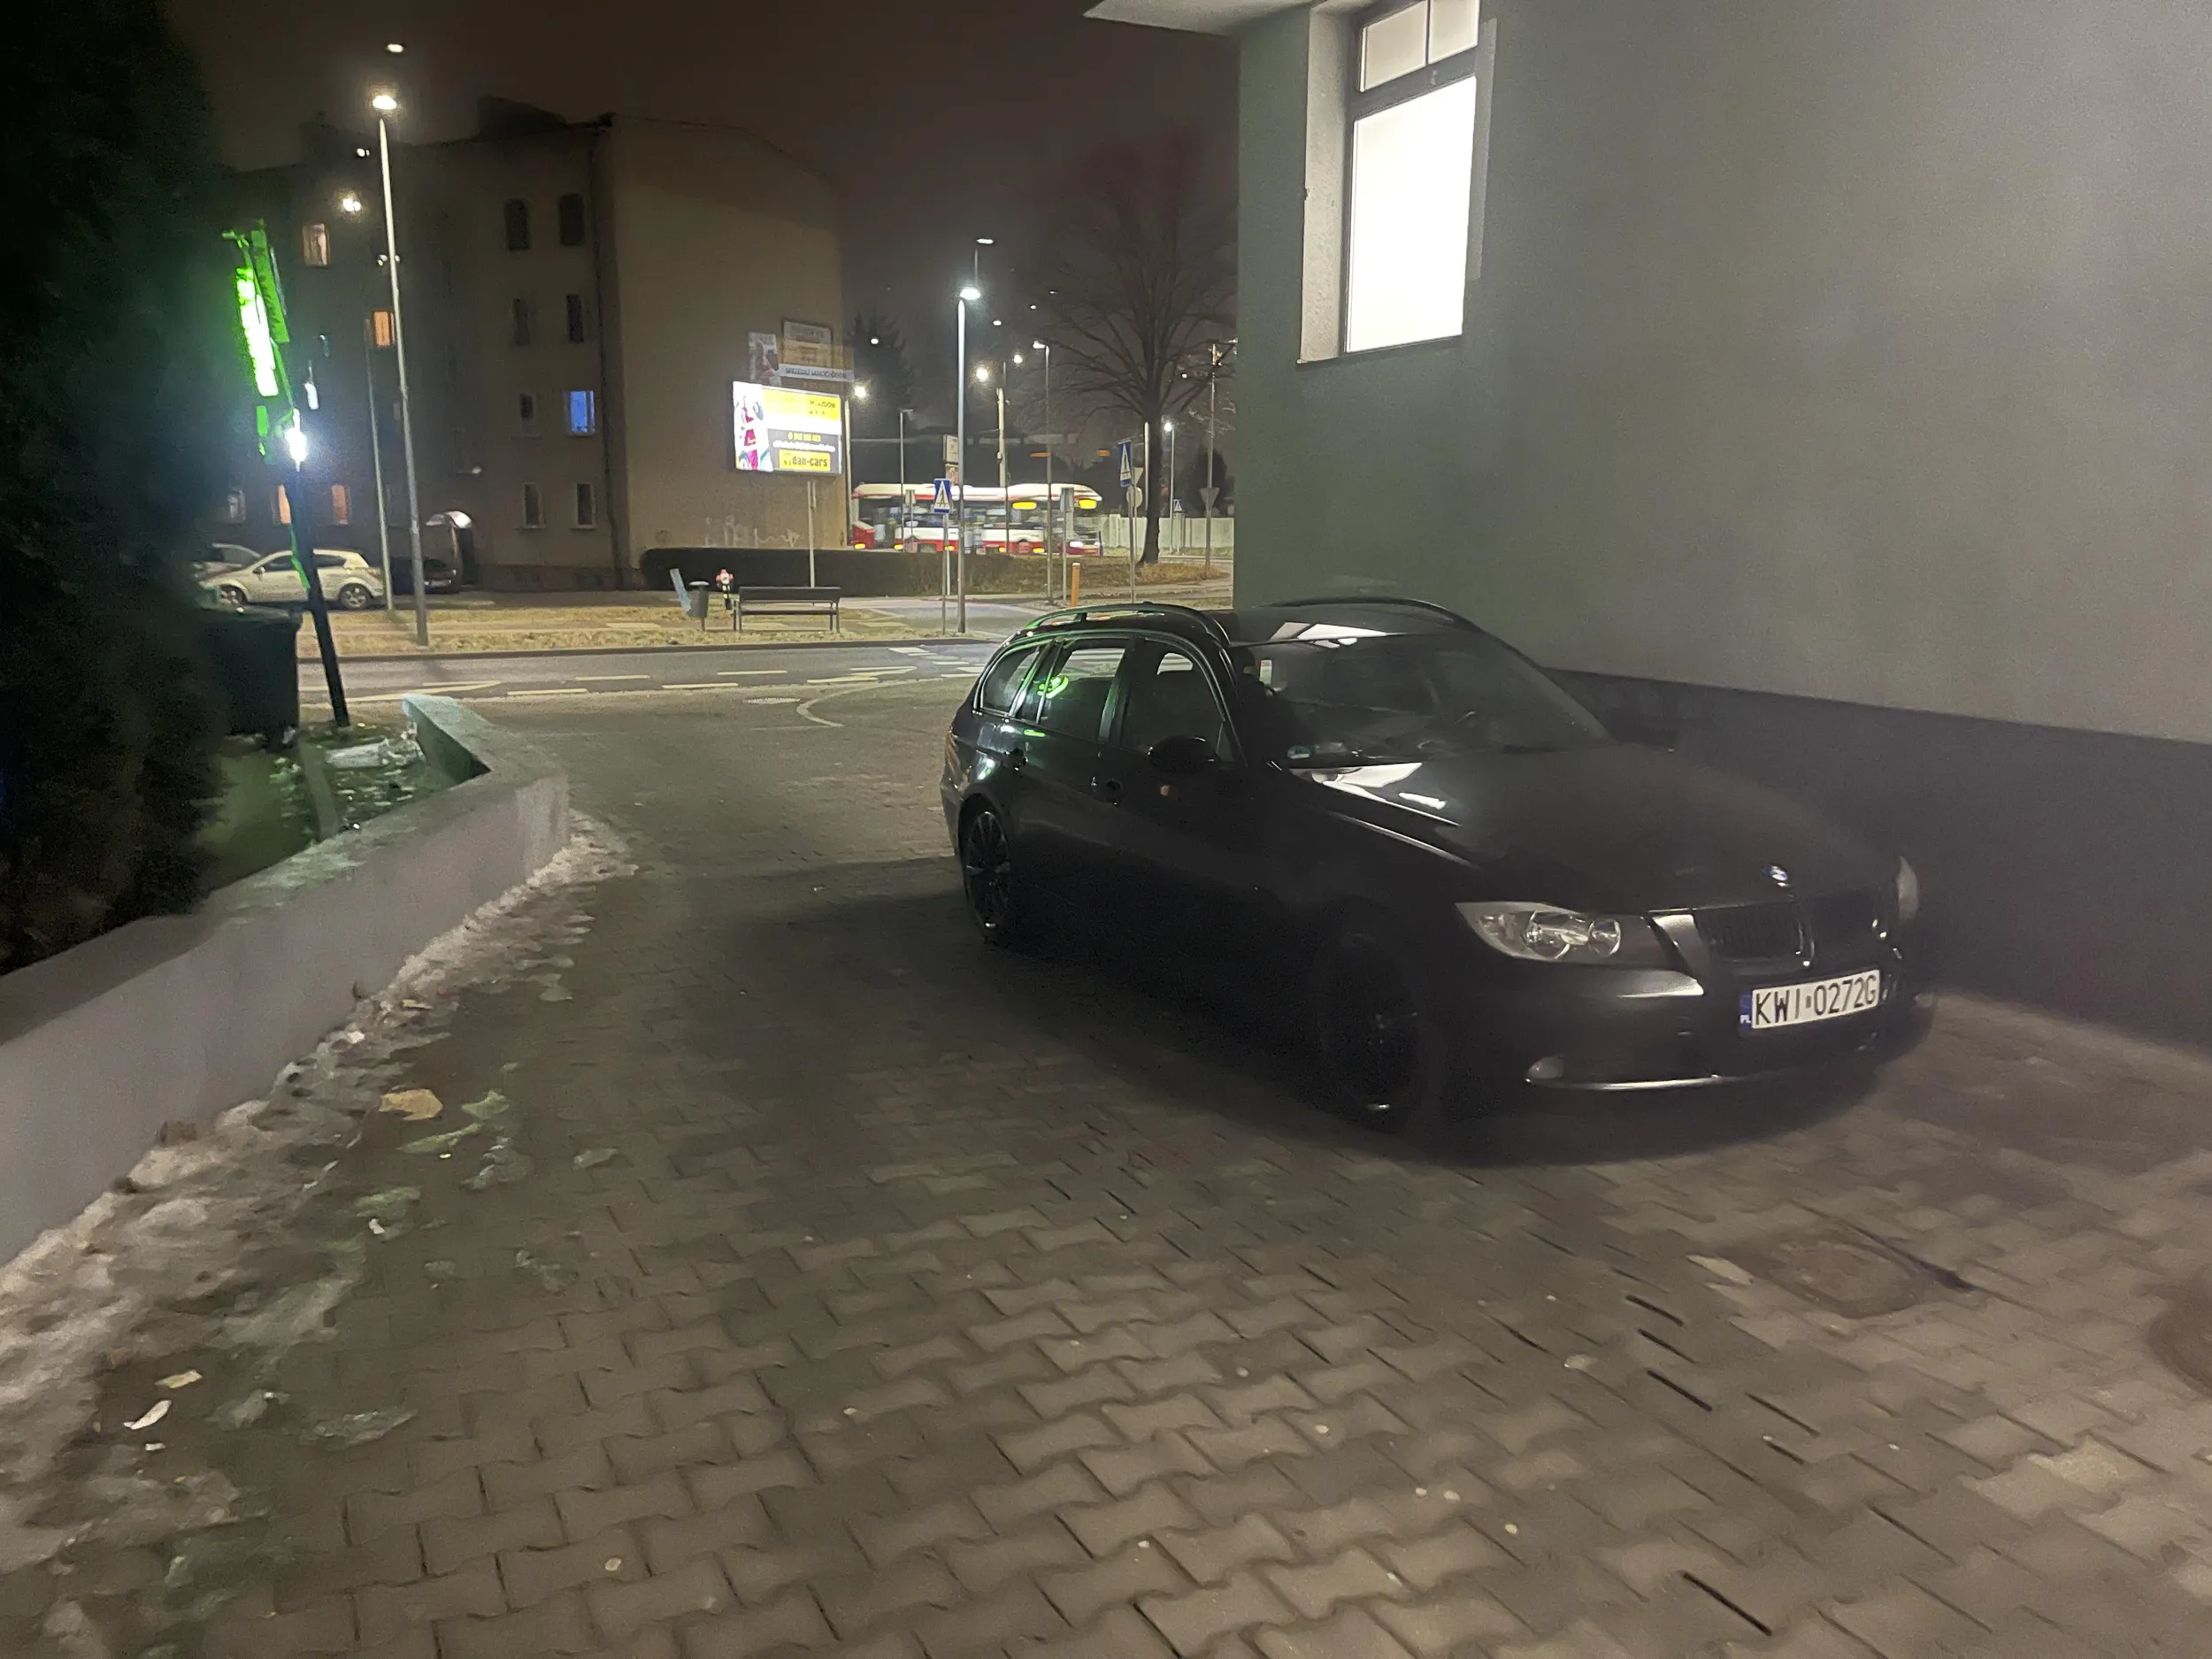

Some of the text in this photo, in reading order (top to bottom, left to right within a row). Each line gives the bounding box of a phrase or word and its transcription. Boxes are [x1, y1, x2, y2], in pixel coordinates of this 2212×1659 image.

[792, 455, 828, 466] dan-cars
[1755, 975, 1877, 1025] KWI 0272G
